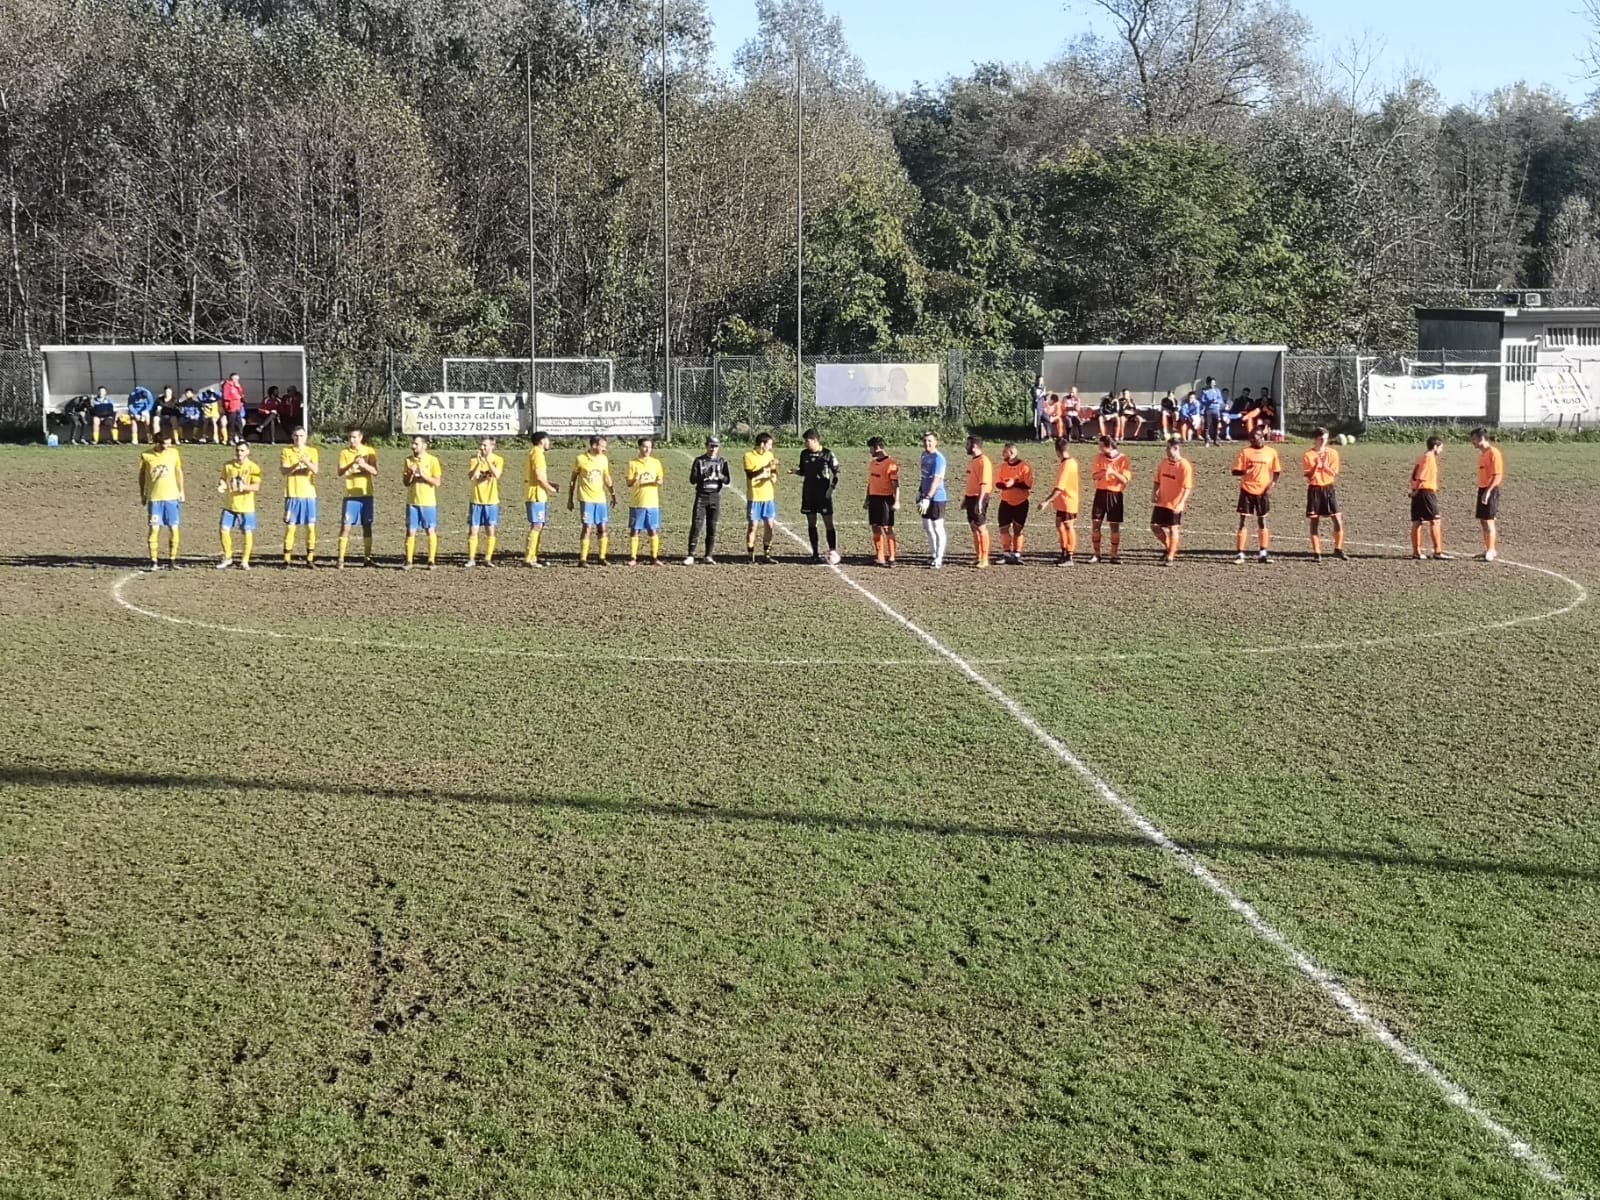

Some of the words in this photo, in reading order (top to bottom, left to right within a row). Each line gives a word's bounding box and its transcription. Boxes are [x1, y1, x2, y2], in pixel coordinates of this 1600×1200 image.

[1411, 379, 1445, 390] AVIS
[404, 395, 526, 409] SAITEM
[588, 400, 621, 412] GM
[417, 411, 471, 419] Assistenza
[474, 411, 511, 419] caldaie
[416, 421, 437, 431] Tel.
[440, 422, 510, 431] 0332782551
